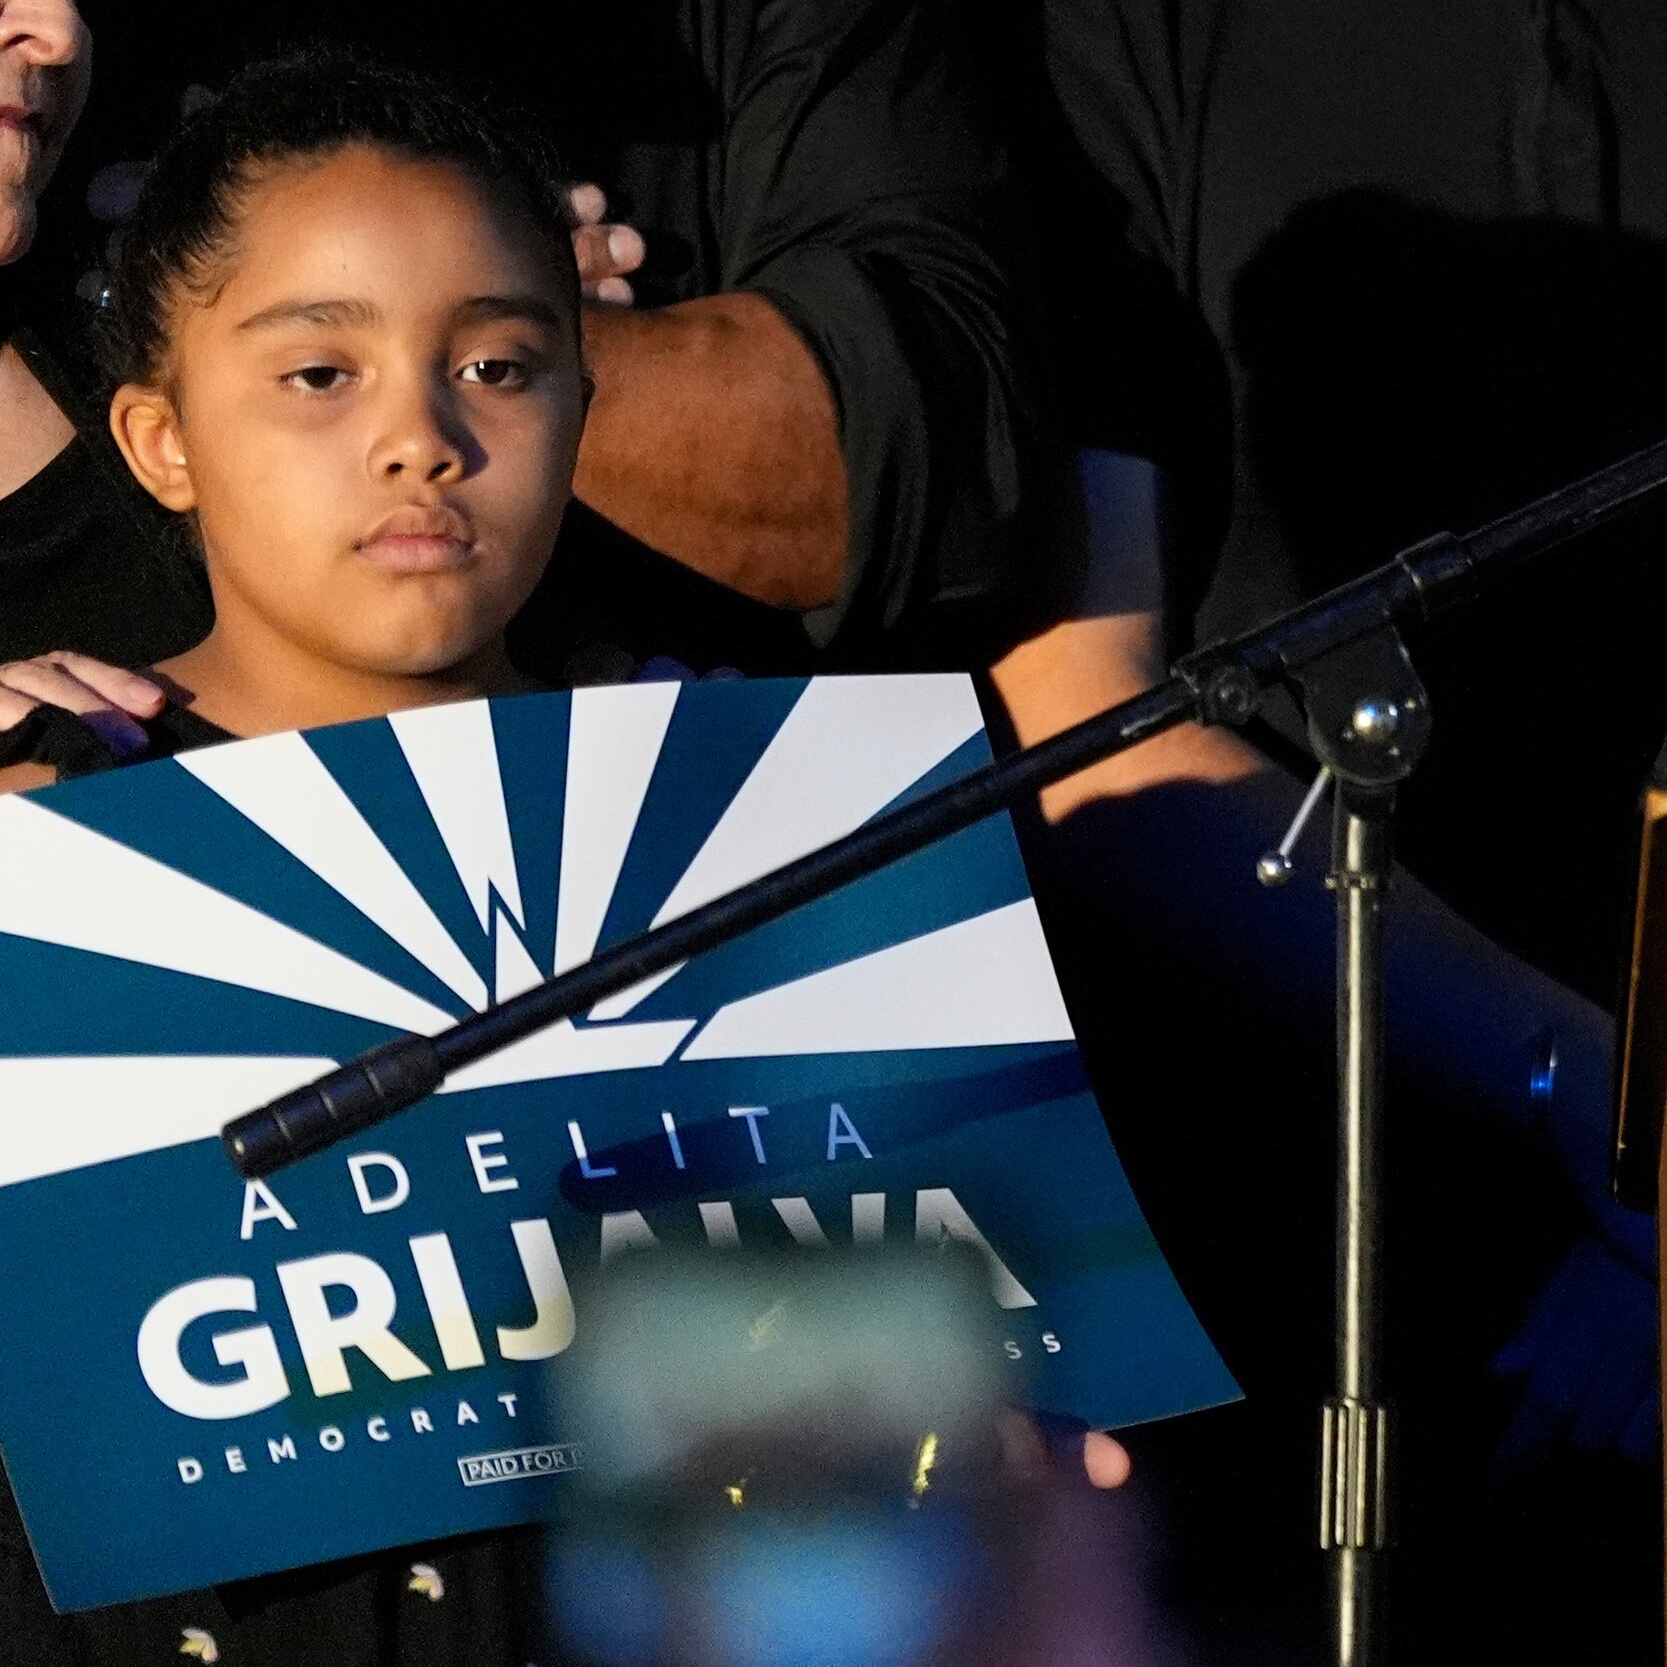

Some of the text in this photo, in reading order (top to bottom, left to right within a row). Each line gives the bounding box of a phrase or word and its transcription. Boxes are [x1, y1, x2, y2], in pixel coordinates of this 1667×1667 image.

[240, 1103, 873, 1240] ADELITA
[177, 1392, 520, 1485] DEMOCRAT
[466, 1455, 520, 1481] PAID
[522, 1449, 567, 1472] FOR
